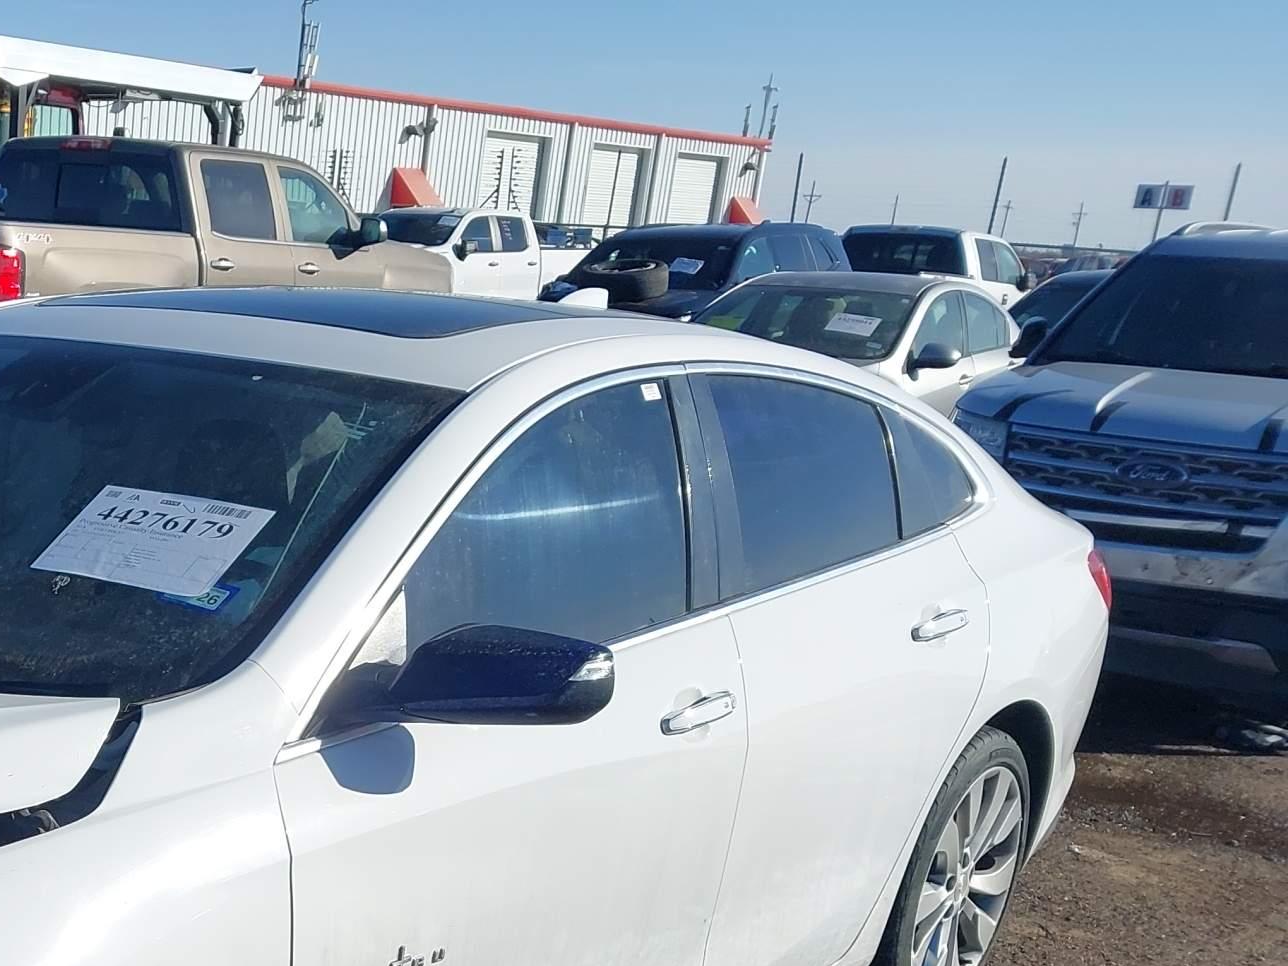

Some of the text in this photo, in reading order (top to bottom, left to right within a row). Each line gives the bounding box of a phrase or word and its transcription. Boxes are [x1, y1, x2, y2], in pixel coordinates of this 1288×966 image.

[1141, 187, 1153, 206] A
[97, 506, 234, 538] 44276179
[149, 529, 183, 539] Insurance
[196, 592, 221, 605] 26
